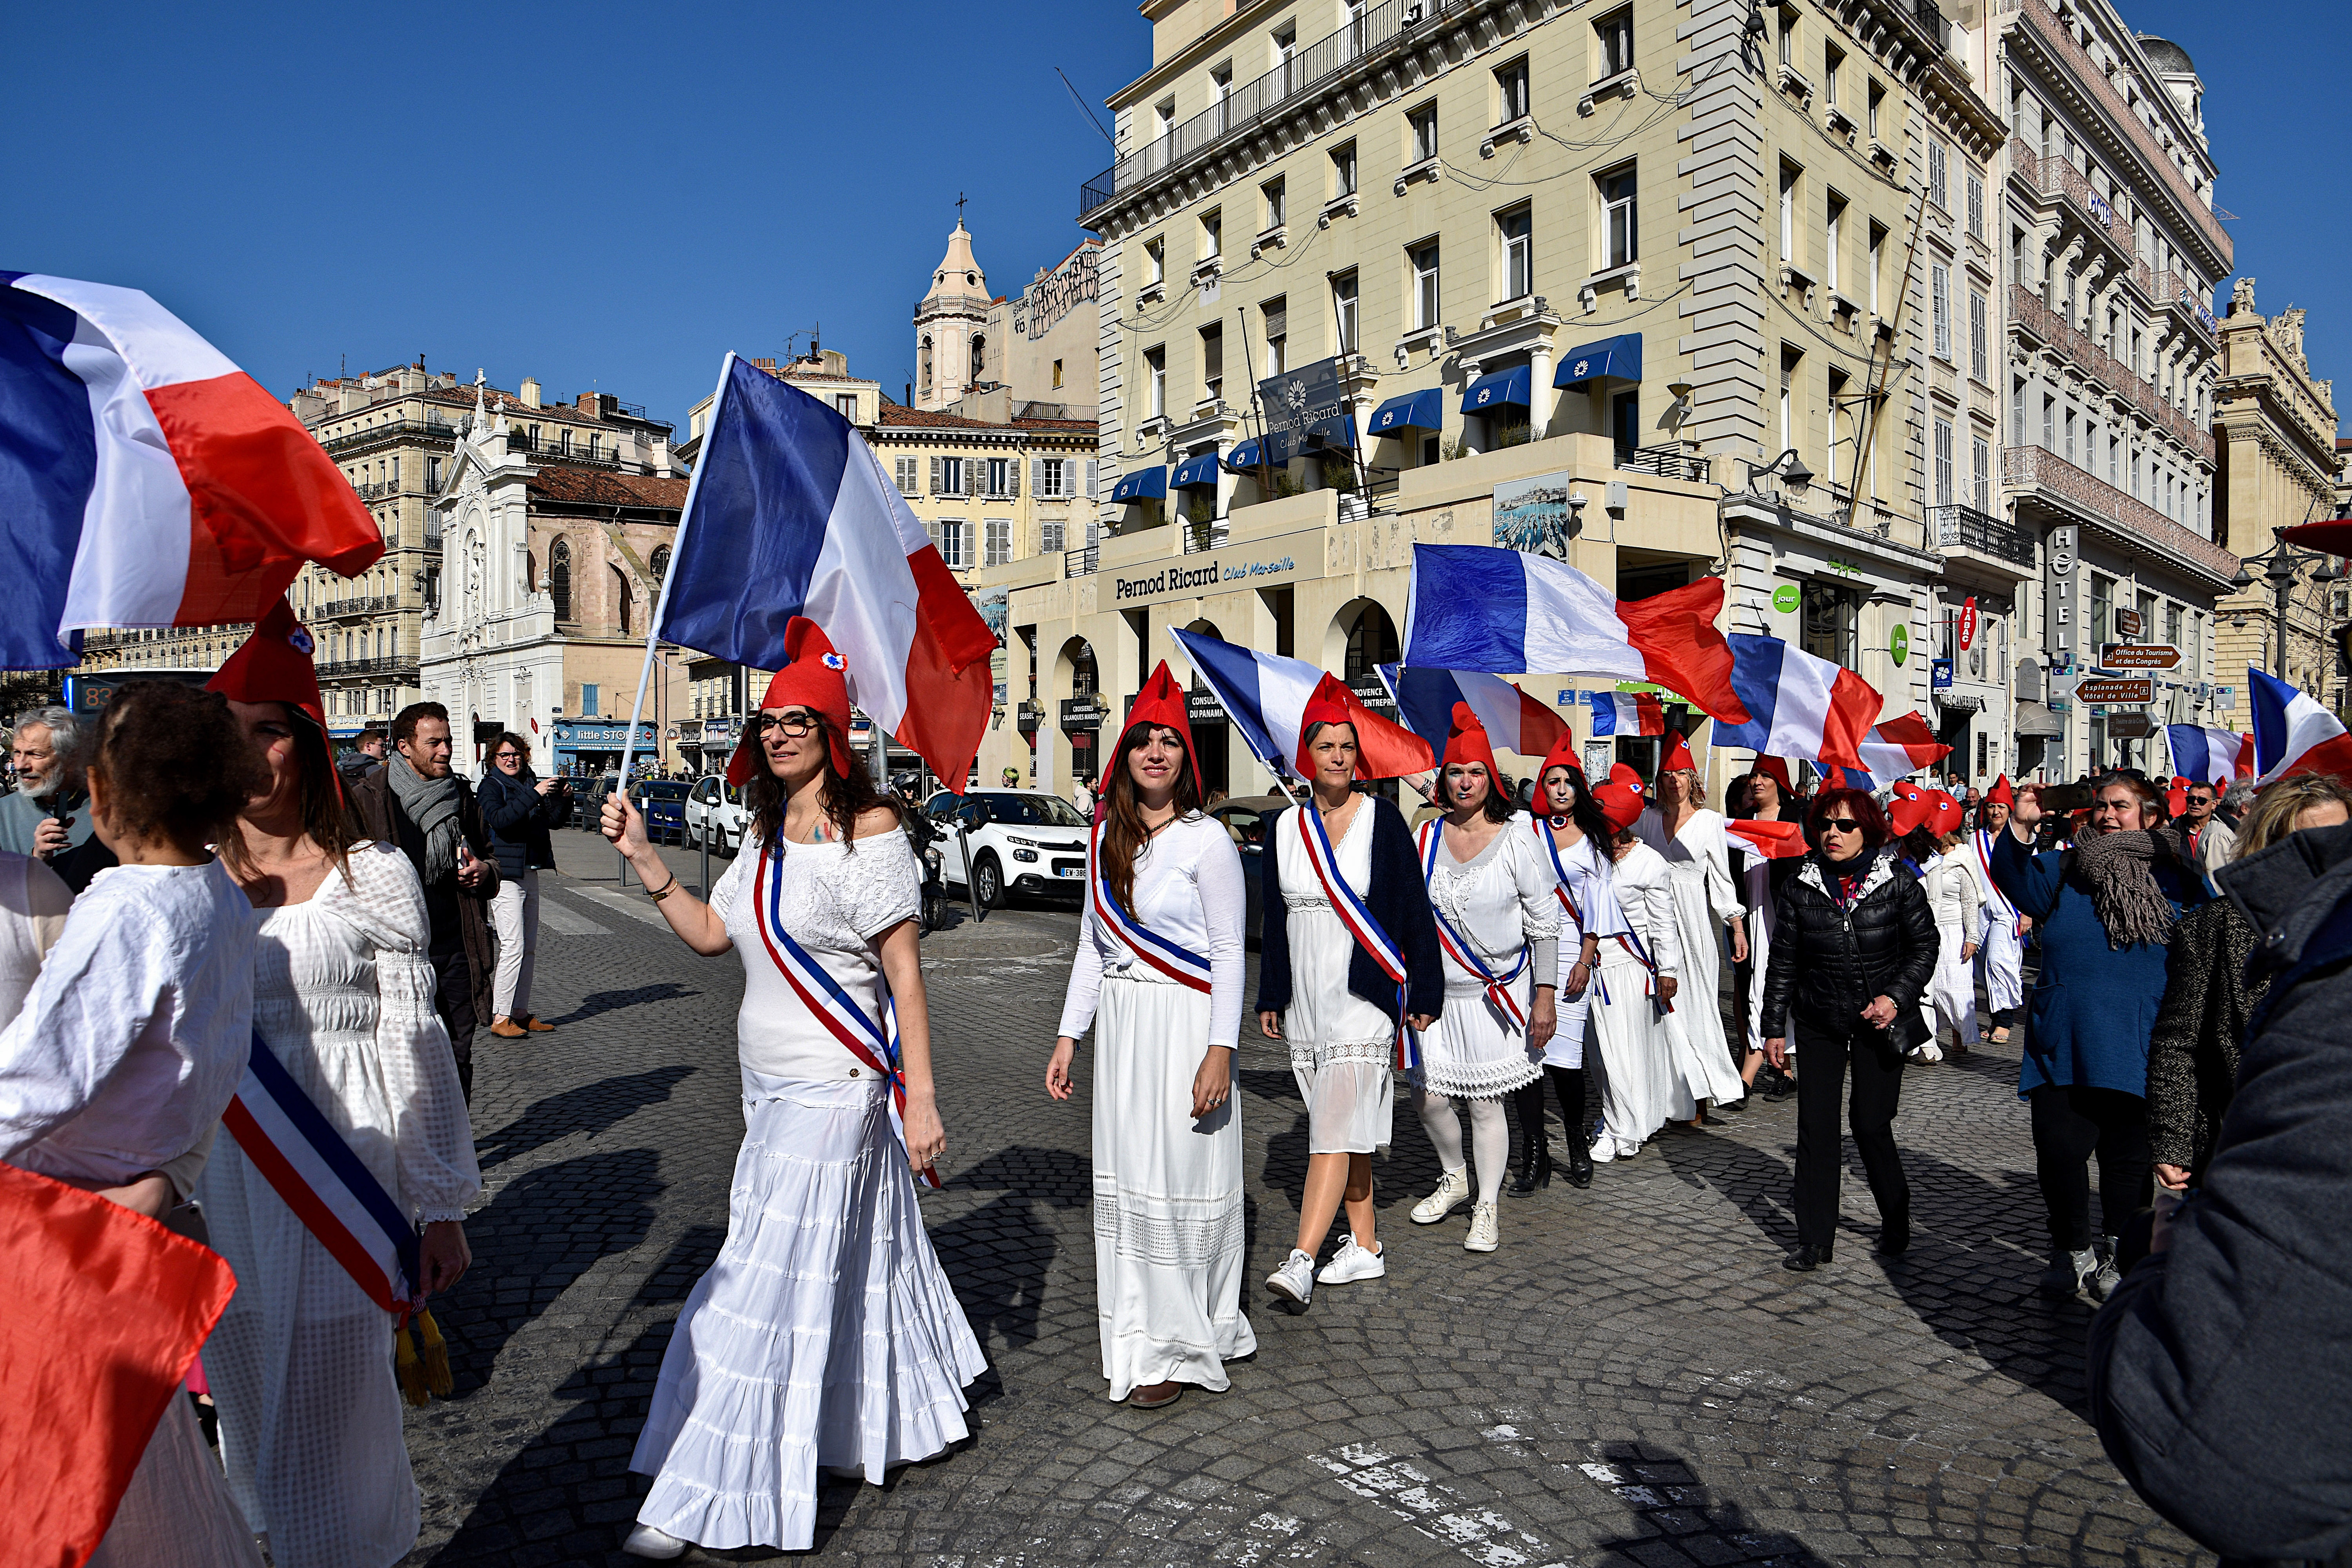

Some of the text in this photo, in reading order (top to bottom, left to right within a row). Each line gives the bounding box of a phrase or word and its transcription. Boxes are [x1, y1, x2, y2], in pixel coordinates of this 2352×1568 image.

[1044, 273, 1058, 296] PAS
[1268, 403, 1340, 435] Pernod Ricard
[1280, 435, 1296, 448] Club
[1116, 556, 1295, 600] Pernod Ricard Club Marseille
[2051, 529, 2074, 648] HOTEL
[1775, 594, 1796, 604] jour
[1962, 606, 1972, 643] TABAC
[1192, 696, 1221, 705] CONSULA
[1199, 708, 1224, 718] PANAMA
[578, 730, 600, 740] little
